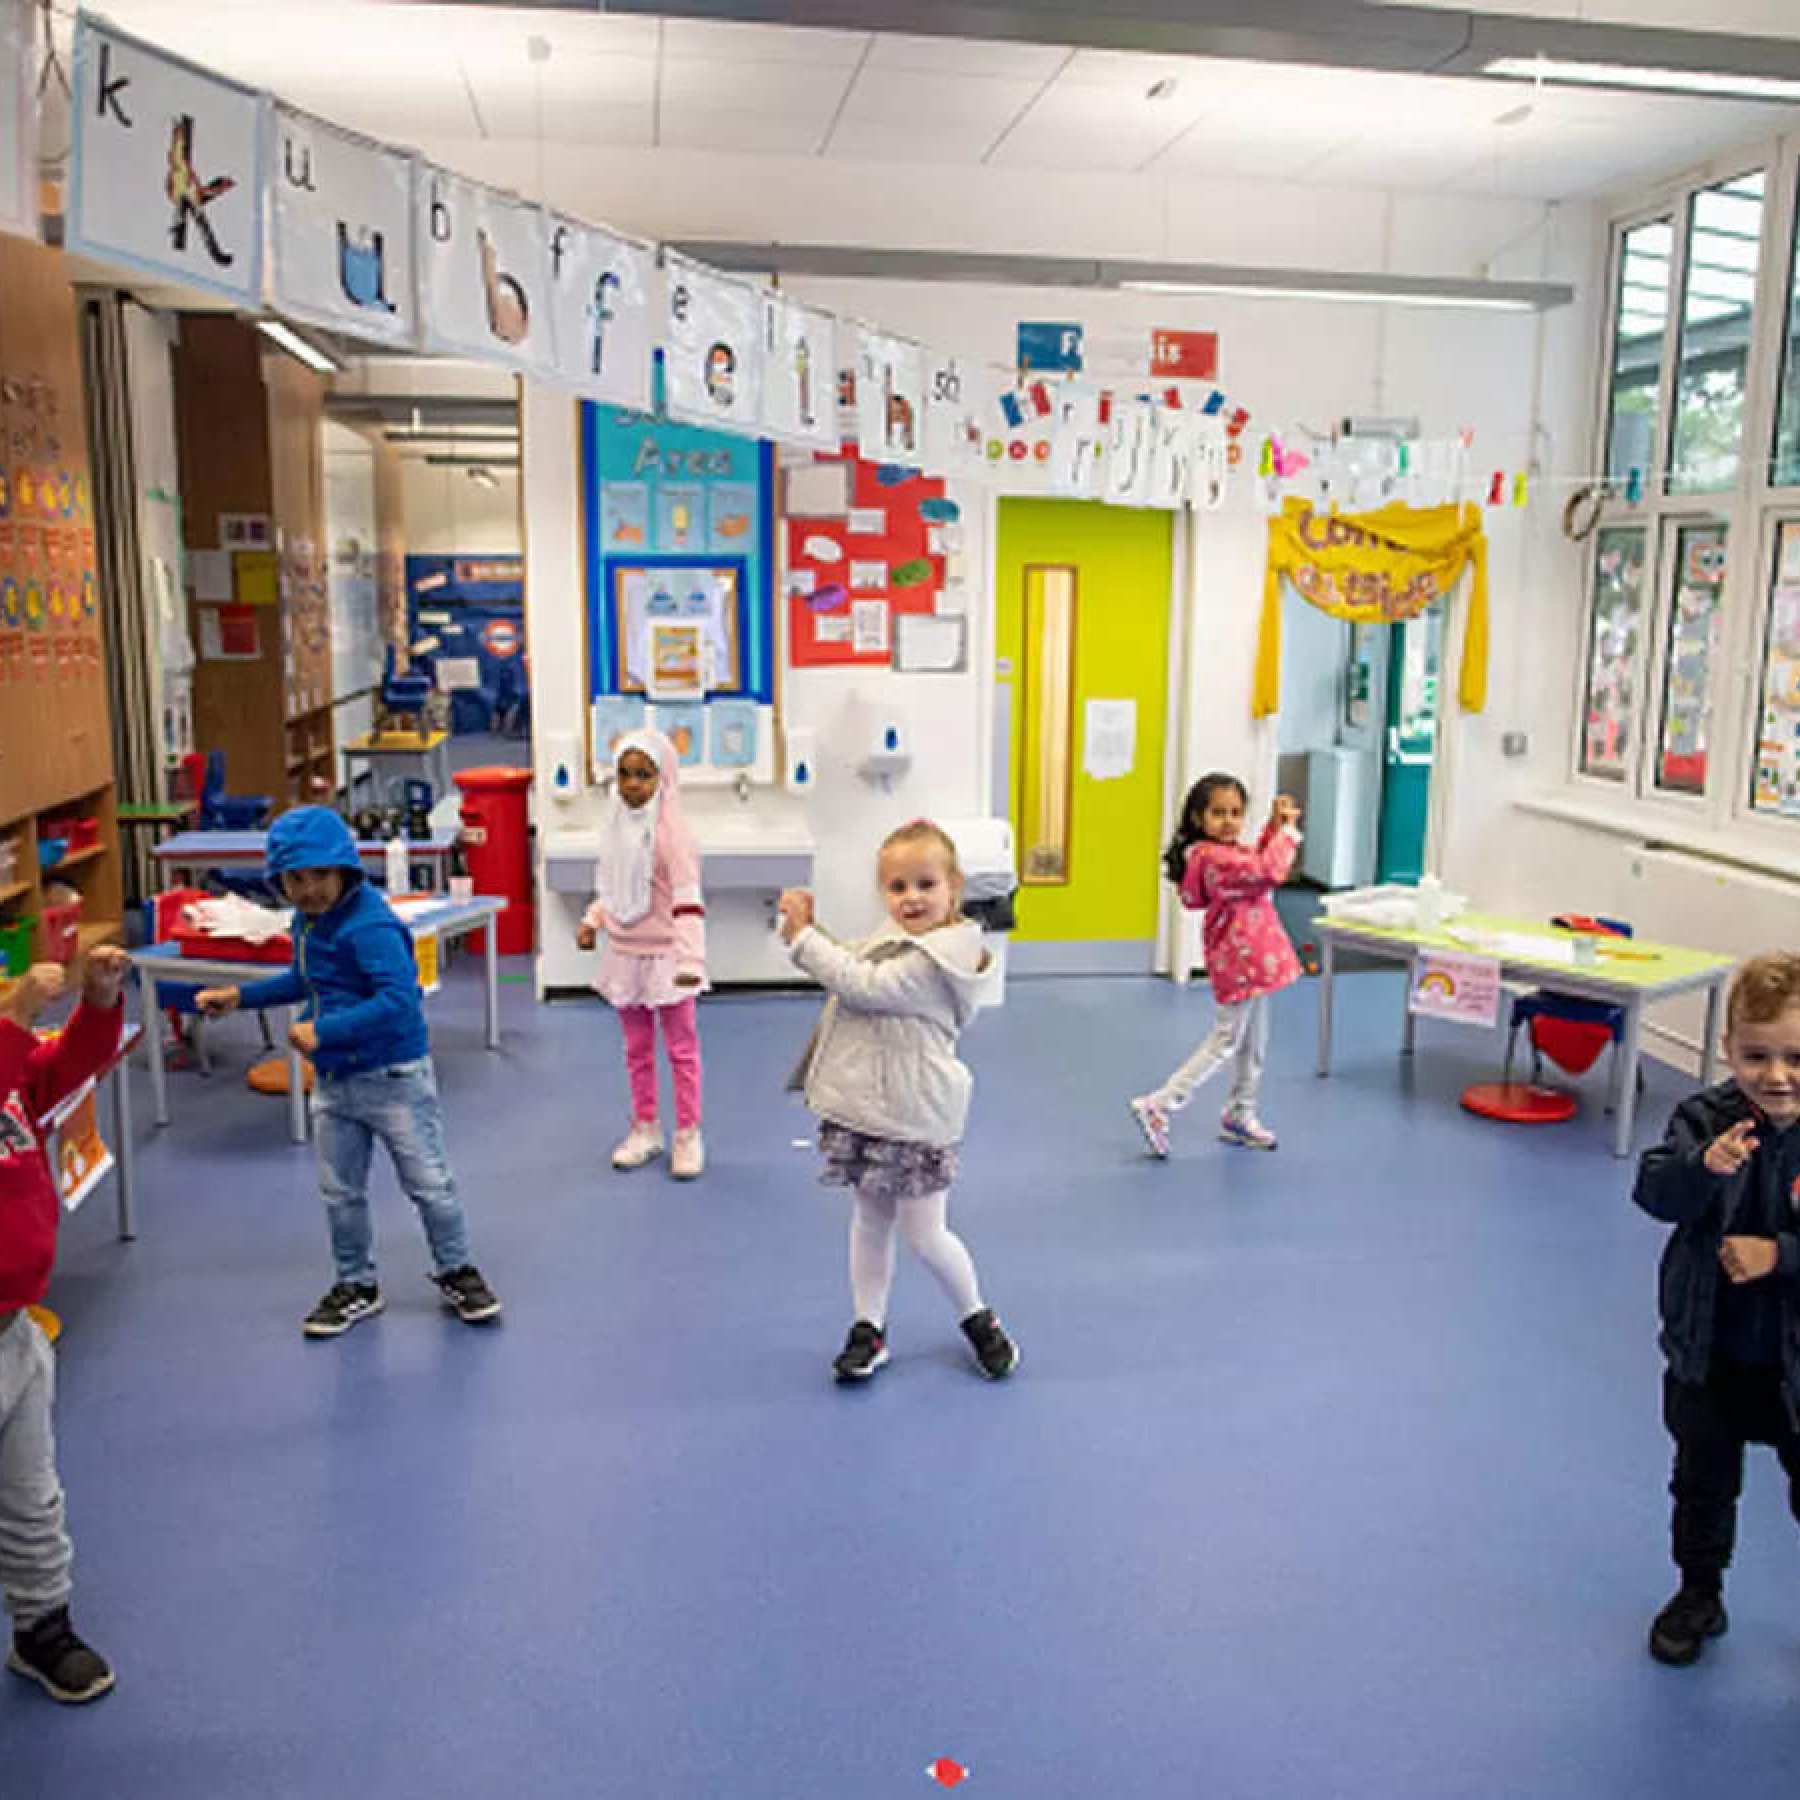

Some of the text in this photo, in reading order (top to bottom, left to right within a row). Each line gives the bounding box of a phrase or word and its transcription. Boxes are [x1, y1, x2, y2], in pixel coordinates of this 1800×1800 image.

[97, 44, 132, 128] k
[285, 138, 315, 192] u
[431, 170, 451, 242] b
[549, 226, 568, 281] f
[672, 285, 690, 320] e
[632, 436, 733, 478] Area
